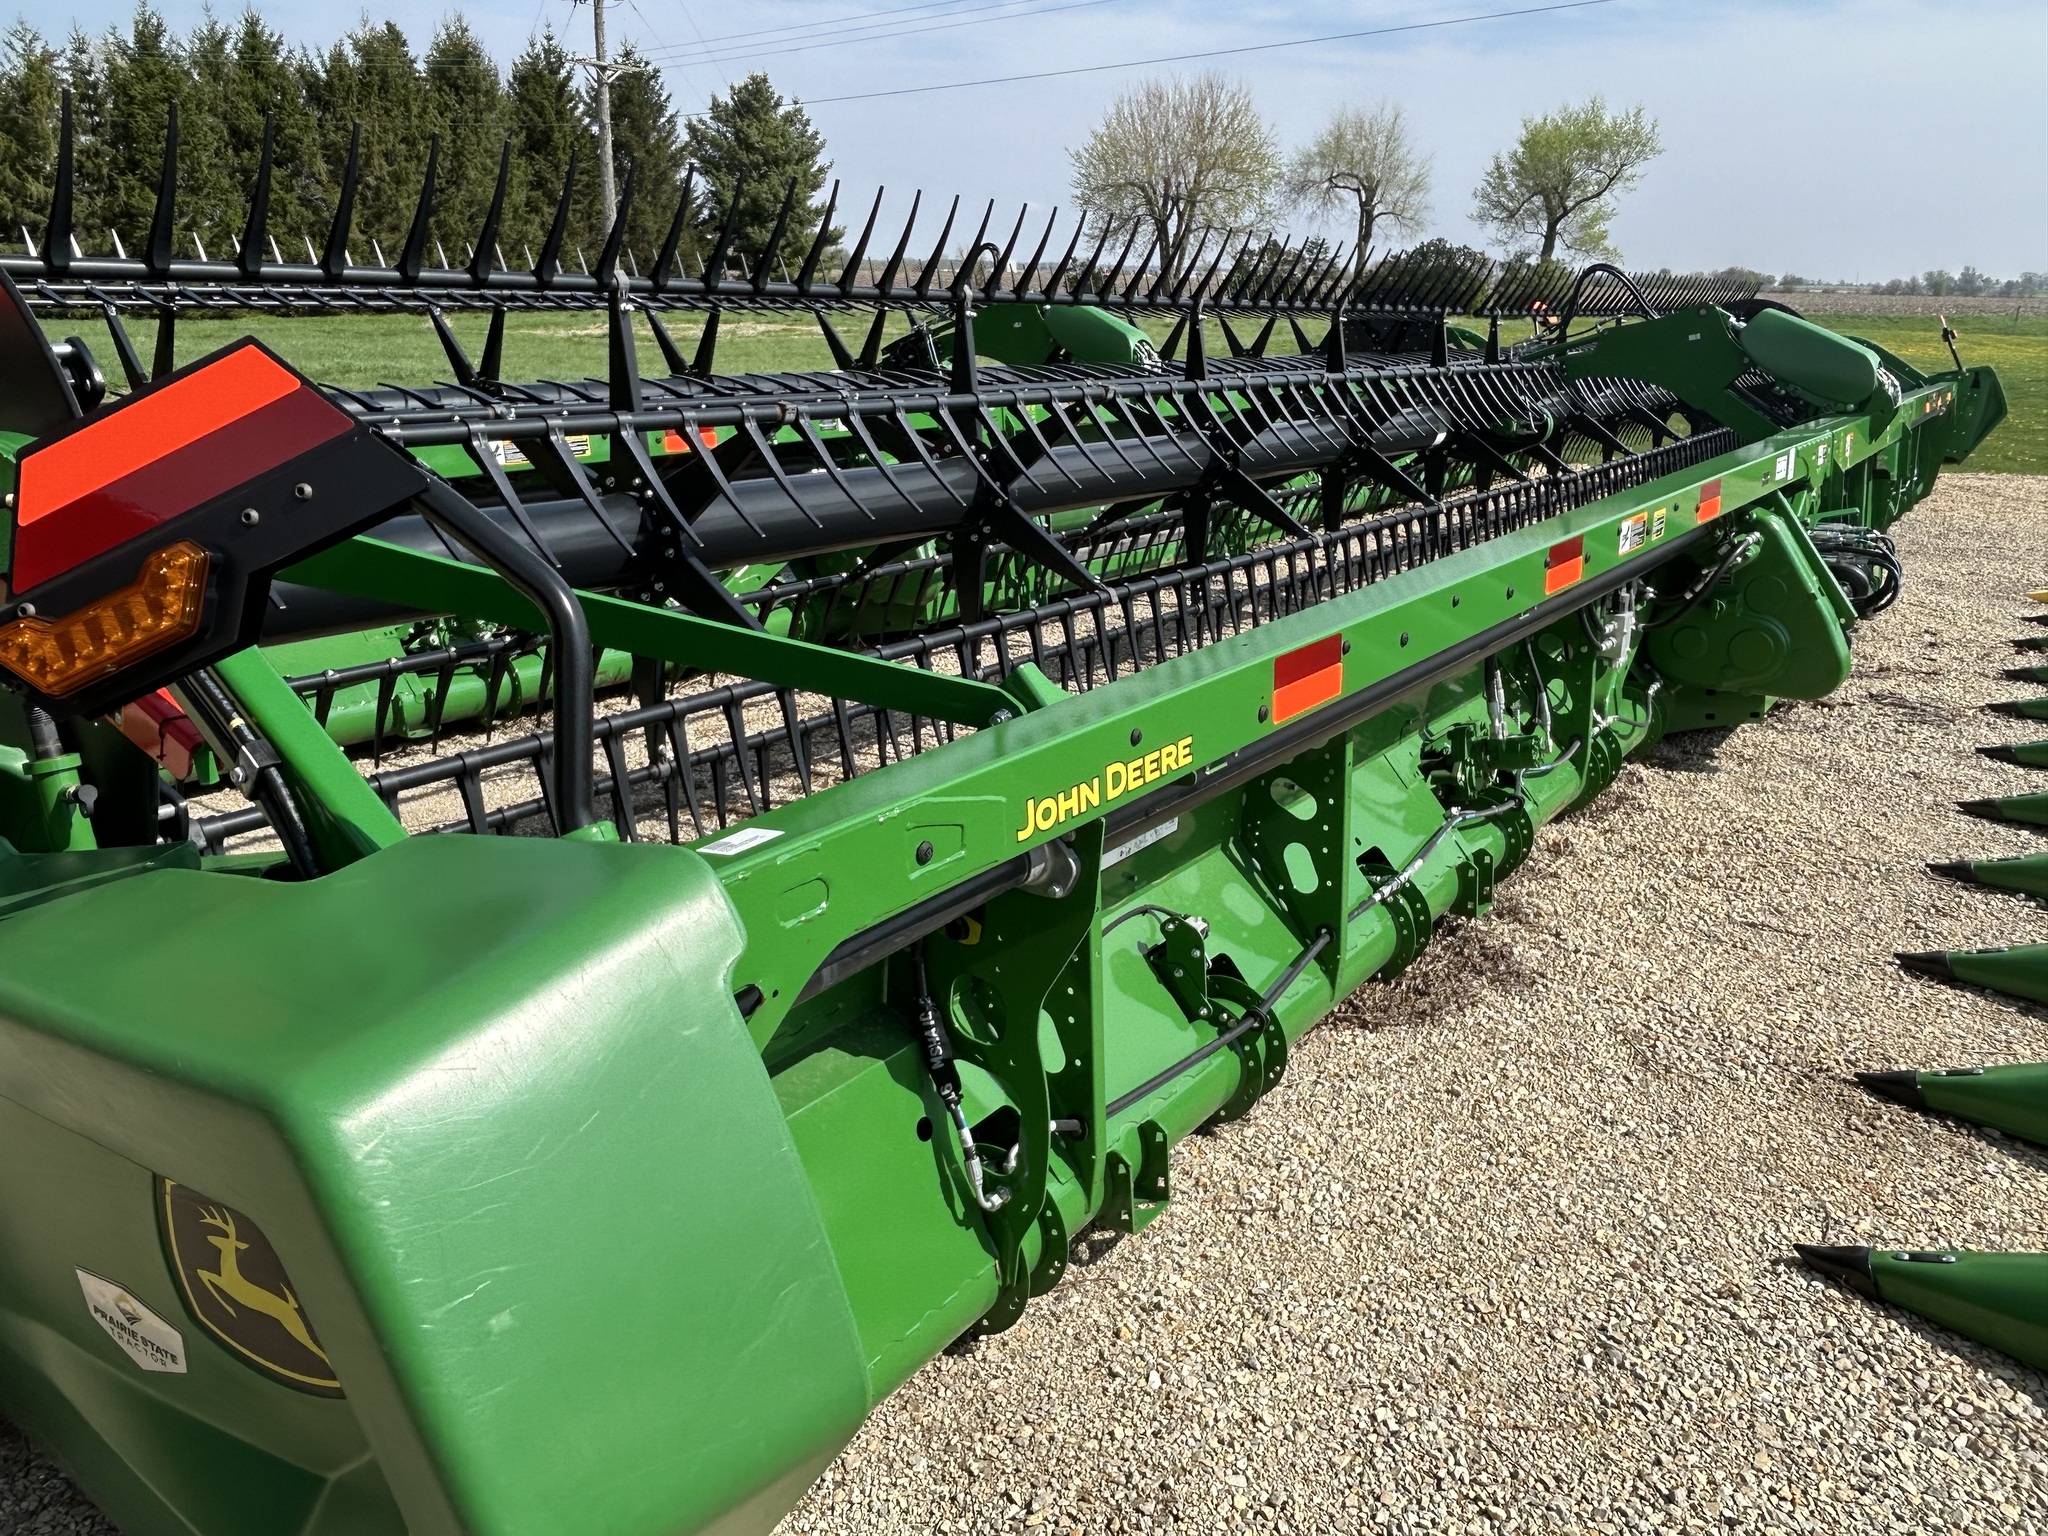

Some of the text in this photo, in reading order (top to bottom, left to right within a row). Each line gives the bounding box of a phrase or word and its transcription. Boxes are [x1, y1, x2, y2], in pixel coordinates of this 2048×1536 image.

[1017, 775, 1100, 842] JOHN
[1105, 735, 1193, 802] DEERE
[93, 1304, 179, 1366] PRAIRIE STATE
[109, 1326, 167, 1368] TRACTOR
